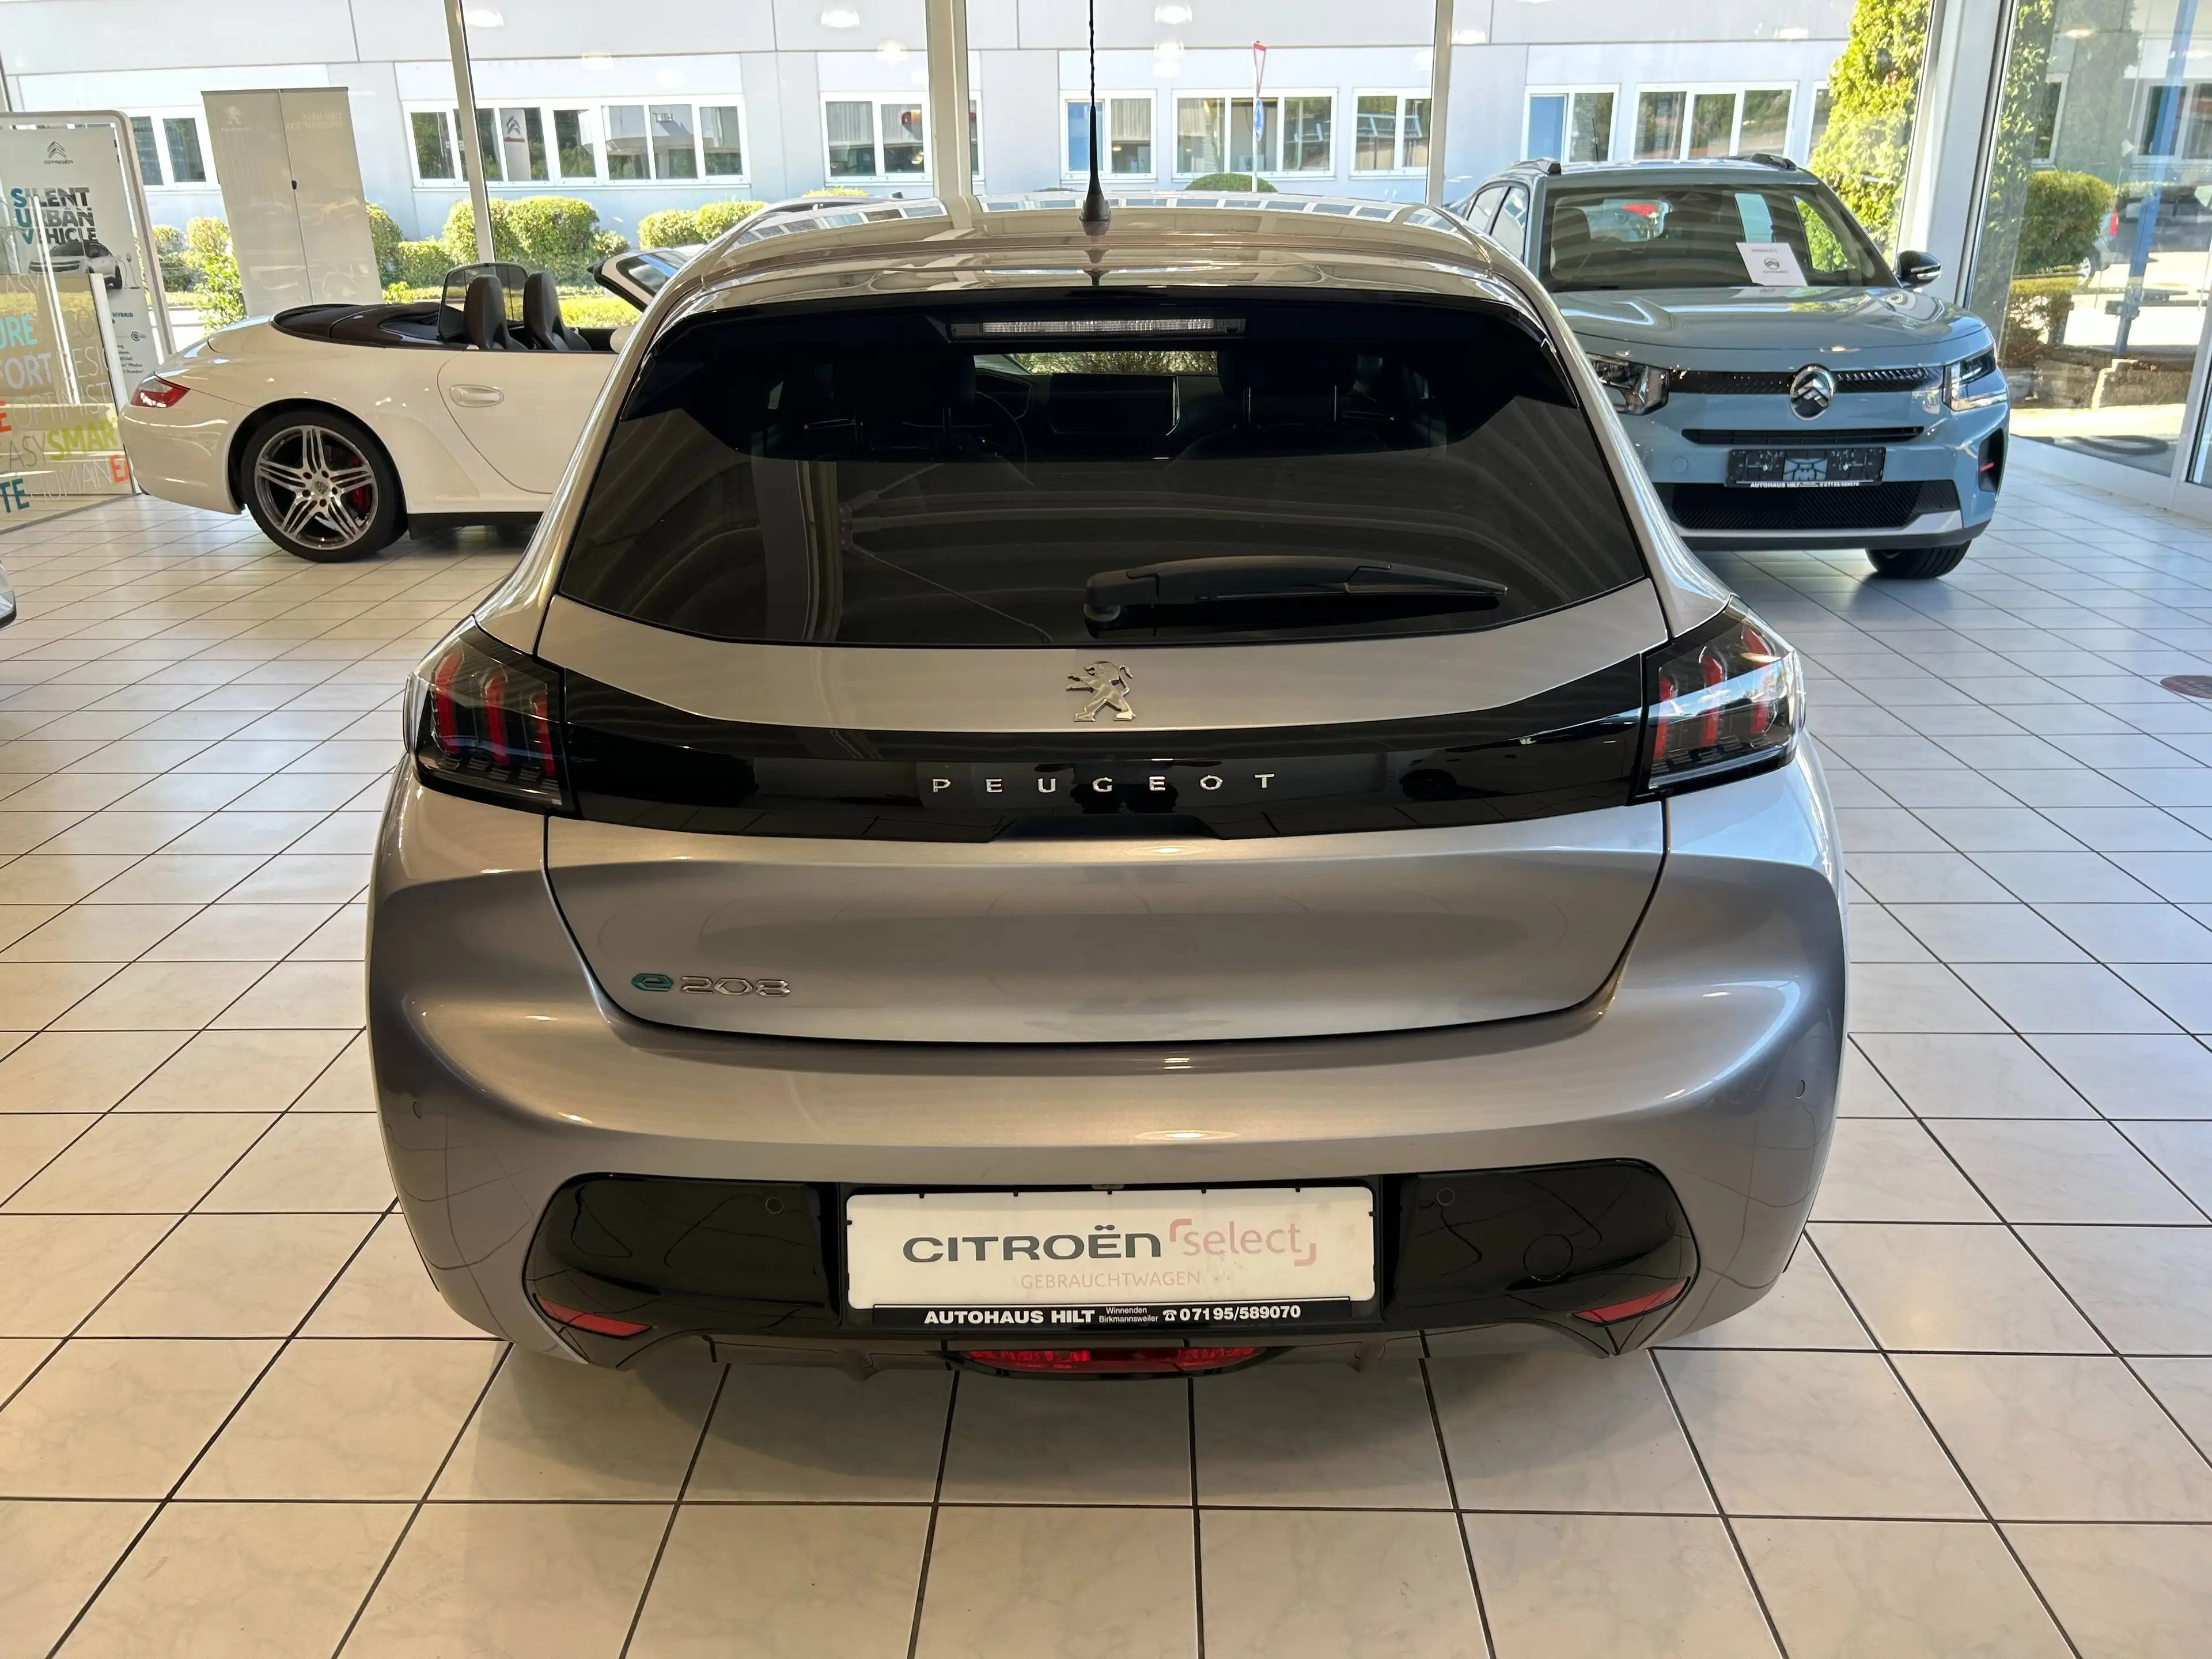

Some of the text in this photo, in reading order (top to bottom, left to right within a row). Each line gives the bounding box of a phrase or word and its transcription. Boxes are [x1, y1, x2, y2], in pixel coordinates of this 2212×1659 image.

[10, 187, 90, 207] SILENT
[0, 353, 53, 389] ORT
[0, 432, 46, 471] ASY
[931, 773, 1275, 793] PEUGEOT
[903, 1221, 1303, 1263] CITROËN select
[1021, 1271, 1200, 1289] GEBRAUCHTWAGEN
[923, 1309, 1095, 1324] AUTOHAUS HILT
[1099, 1315, 1159, 1323] Birkmannsweiler
[1105, 1306, 1147, 1315] Winnenden
[1180, 1305, 1301, 1321] 07195/589070
